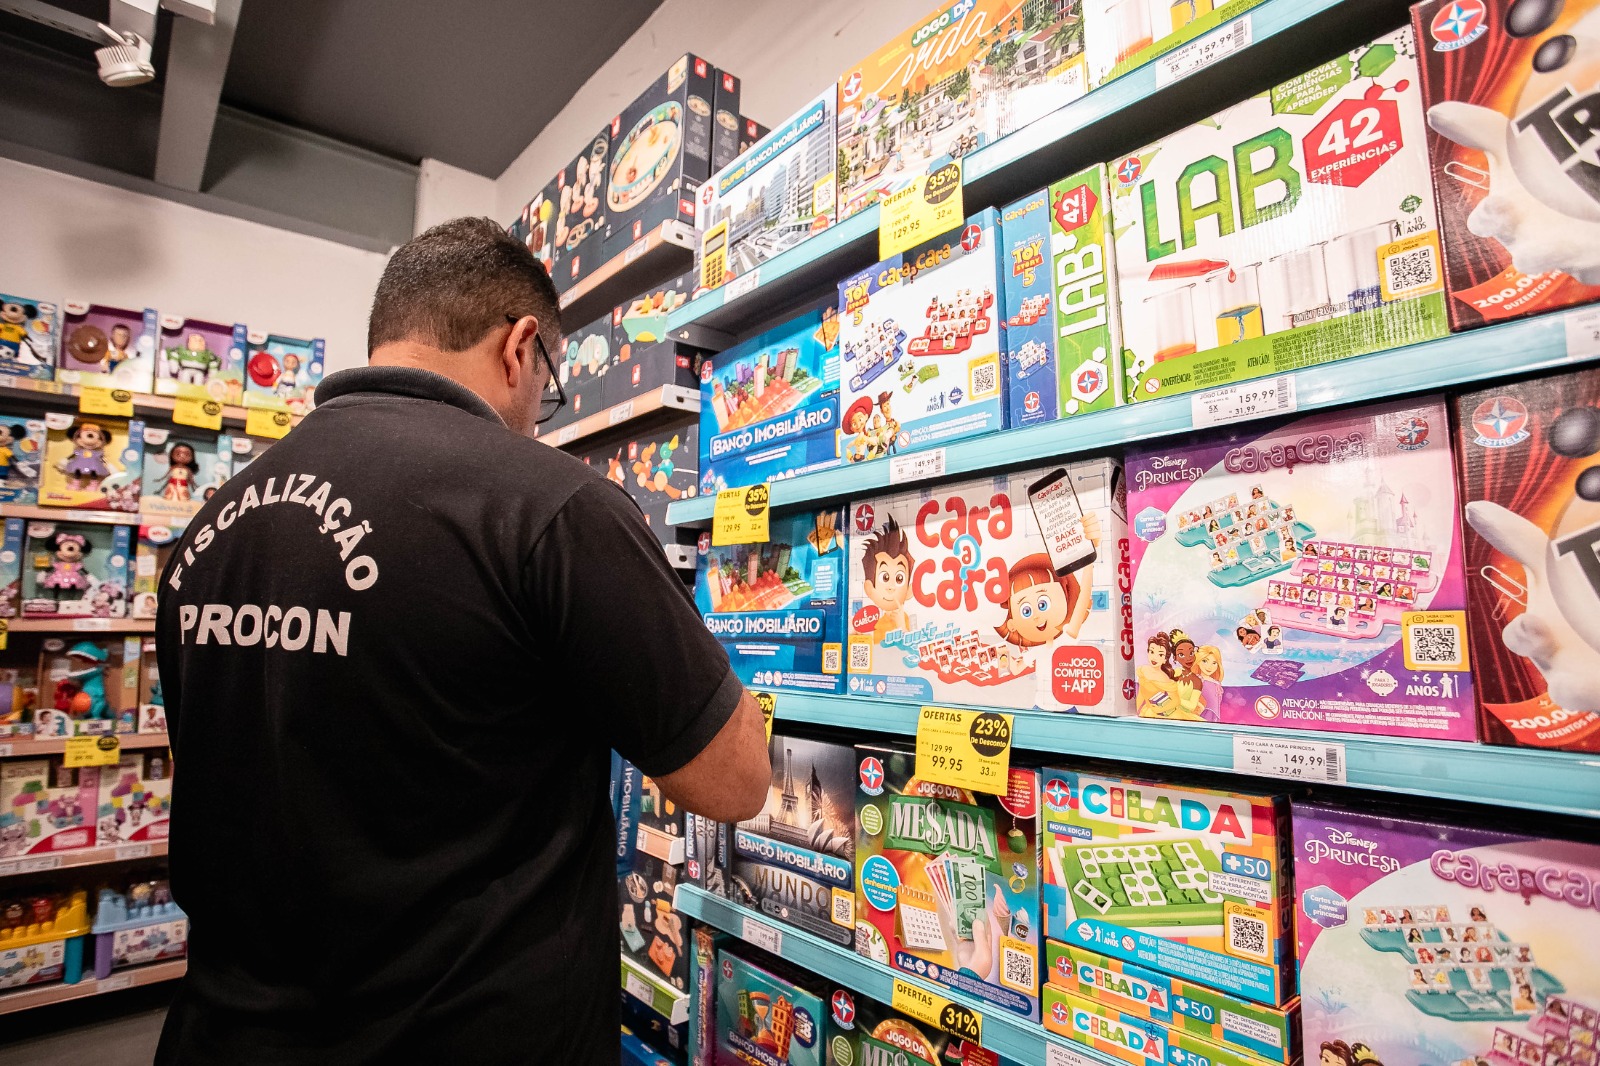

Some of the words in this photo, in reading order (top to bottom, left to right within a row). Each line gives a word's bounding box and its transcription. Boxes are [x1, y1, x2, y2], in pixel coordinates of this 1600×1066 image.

[912, 13, 951, 46] JOGO
[1433, 27, 1487, 51] ESTRELA
[1275, 68, 1343, 103] EXPERIÊNCIAS
[1277, 73, 1302, 96] COM
[1301, 60, 1339, 83] NOVAS
[1285, 85, 1339, 114] APRENDER!
[1295, 84, 1322, 104] PARA
[1317, 107, 1384, 157] 42
[1310, 141, 1398, 180] EXPERIÊNCIAS
[929, 164, 958, 190] 35%
[883, 184, 917, 207] OFERTAS
[1139, 126, 1303, 262] LAB
[1061, 193, 1080, 225] 42
[1406, 222, 1427, 234] ANOS
[1011, 240, 1042, 265] TOY
[1021, 268, 1035, 288] 5
[844, 278, 873, 304] TOY
[1058, 243, 1107, 338] LAB
[1502, 279, 1552, 311] DUZENTOS
[853, 308, 864, 327] 5
[1208, 404, 1219, 412] 5X
[713, 431, 753, 457] BANCO
[754, 407, 832, 448] IMOBILIÁRIO
[1395, 438, 1431, 451] ESTRELA
[747, 488, 768, 503] 35%
[169, 473, 379, 591] FISCALIZAÇÃO
[1055, 527, 1077, 543] BAIXE
[180, 603, 352, 657] PROCON
[707, 618, 744, 636] BANCO
[744, 612, 820, 635] IMOBILIÁRIO
[854, 614, 880, 628] CARECA?
[1069, 655, 1097, 669] JOGO
[1053, 668, 1102, 681] COMPLETO
[1405, 685, 1441, 697] ANOS
[923, 710, 962, 723] OFERTAS
[975, 718, 1008, 738] 23%
[1535, 718, 1588, 740] DUZENTOS
[970, 736, 978, 744] De
[979, 738, 1007, 748] Desconto
[917, 782, 944, 796] JOGO
[945, 786, 960, 799] DA
[617, 767, 634, 857] IMOBILIÁRIO
[1082, 783, 1246, 840] CILADA
[1050, 823, 1067, 833] NOVA
[1067, 826, 1091, 837] EDIÇÃO
[738, 834, 775, 858] BANCO
[776, 849, 848, 886] IMOBILIÁRIO
[1225, 857, 1268, 878] +50
[754, 866, 831, 908] MUNDO
[1213, 872, 1227, 880] TIPOS
[1228, 876, 1261, 887] DIFERENTES
[1220, 880, 1268, 895] QUEBRA-CABEÇAS
[1227, 886, 1241, 894] VOCÊ
[1310, 894, 1331, 904] Cartas
[1331, 899, 1347, 908] com
[1318, 903, 1338, 912] novas
[1103, 939, 1119, 948] ANOS
[897, 983, 932, 1006] OFERTAS
[1079, 965, 1165, 1008] CILADA
[896, 1002, 909, 1011] JOGO
[917, 1010, 937, 1024] MESADA
[1176, 997, 1212, 1021] +50
[1224, 1011, 1239, 1020] TIPOS
[1240, 1015, 1269, 1030] DIFERENTES
[945, 1008, 977, 1036] 31%
[1224, 1022, 1238, 1030] PARA
[1238, 1025, 1253, 1035] VOCÊ
[729, 1031, 755, 1054] BANCO
[886, 1030, 914, 1049] JOGO
[912, 1040, 926, 1058] DA
[1074, 1012, 1161, 1059] CILADA
[1050, 1048, 1064, 1057] JOGO
